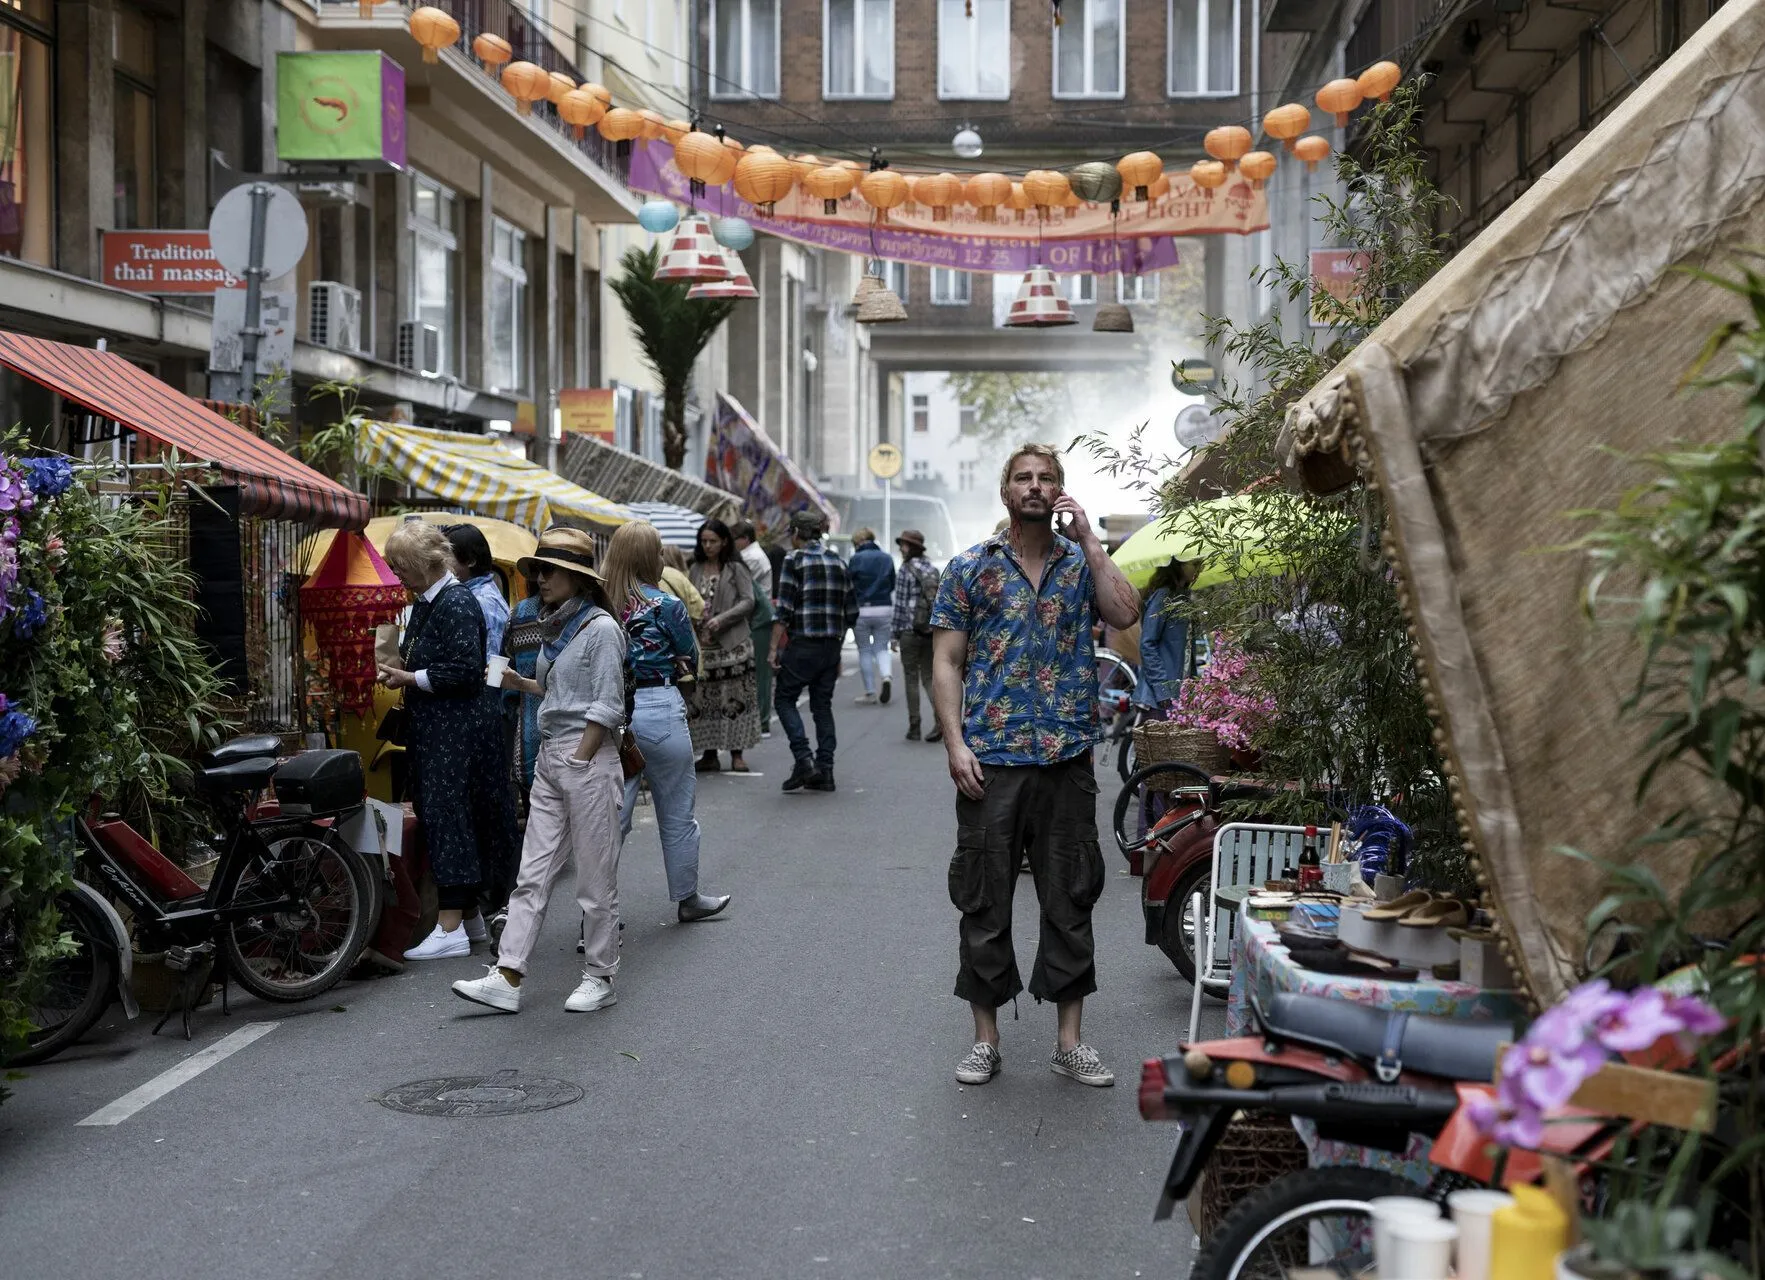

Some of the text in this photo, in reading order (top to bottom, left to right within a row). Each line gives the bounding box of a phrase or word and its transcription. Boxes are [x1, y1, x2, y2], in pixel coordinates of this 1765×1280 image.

[1146, 199, 1214, 219] LIGHT
[130, 243, 215, 260] Tradition
[1050, 246, 1081, 265] OF
[114, 263, 244, 287] thai massag
